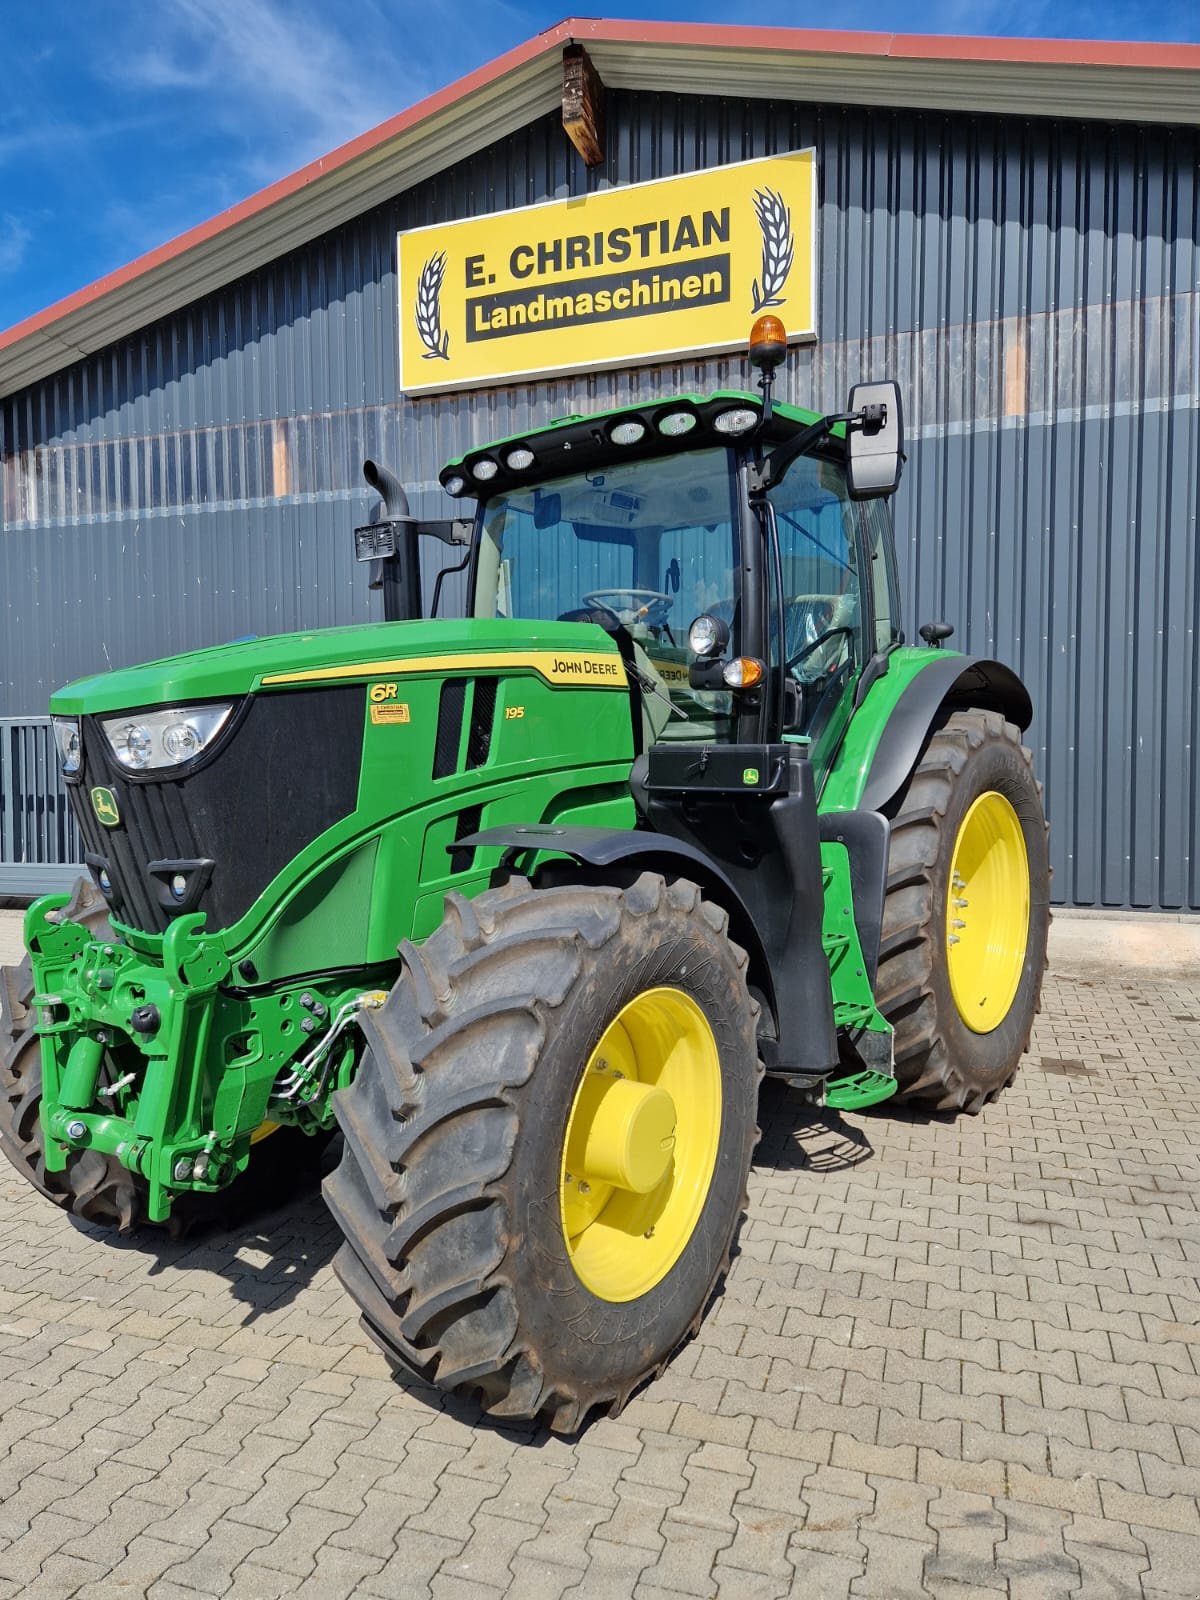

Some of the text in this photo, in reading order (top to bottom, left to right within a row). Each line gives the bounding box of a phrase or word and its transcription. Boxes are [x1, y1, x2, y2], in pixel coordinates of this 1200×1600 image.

[465, 206, 731, 289] E. CHRISTIAN
[475, 270, 723, 332] Landmaschinen
[552, 659, 618, 675] JOHN DEERE
[370, 683, 399, 703] 6R
[505, 706, 525, 719] 195
